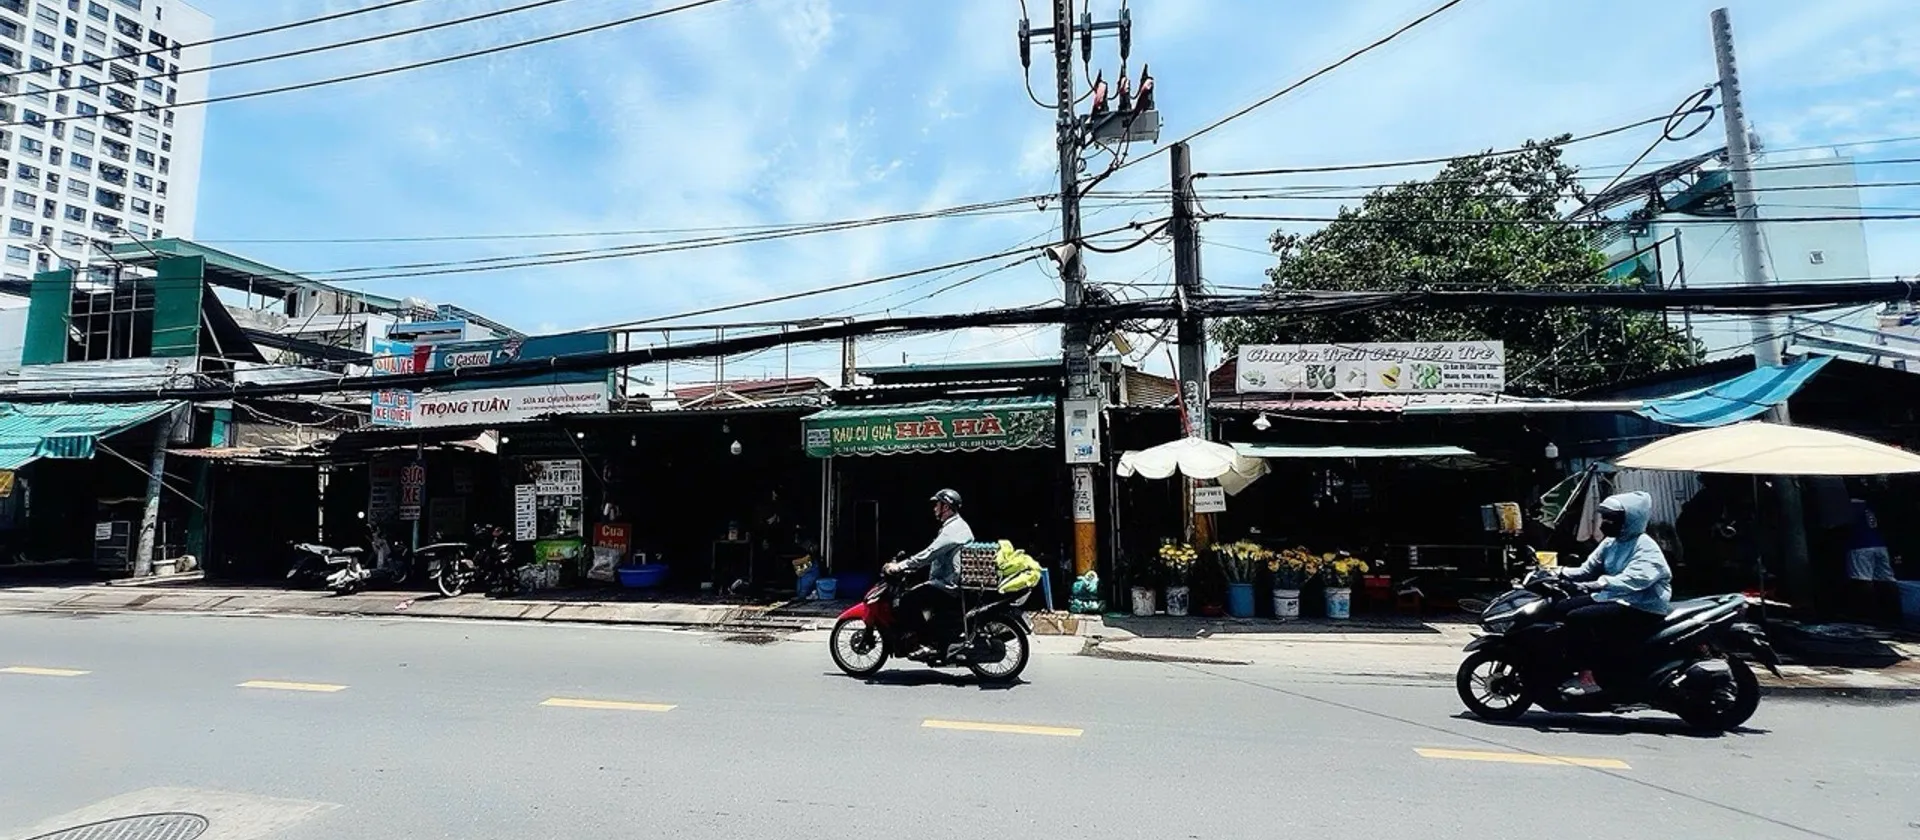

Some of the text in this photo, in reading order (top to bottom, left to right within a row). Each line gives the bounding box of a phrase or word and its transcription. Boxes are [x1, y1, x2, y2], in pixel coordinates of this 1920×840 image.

[456, 352, 490, 367] Castrol
[1458, 345, 1495, 360] Tre
[419, 401, 468, 419] TRỌNG
[832, 427, 853, 443] RAU
[894, 415, 948, 440] HÀ
[952, 412, 1006, 438] HÀ
[601, 525, 624, 537] Cua
